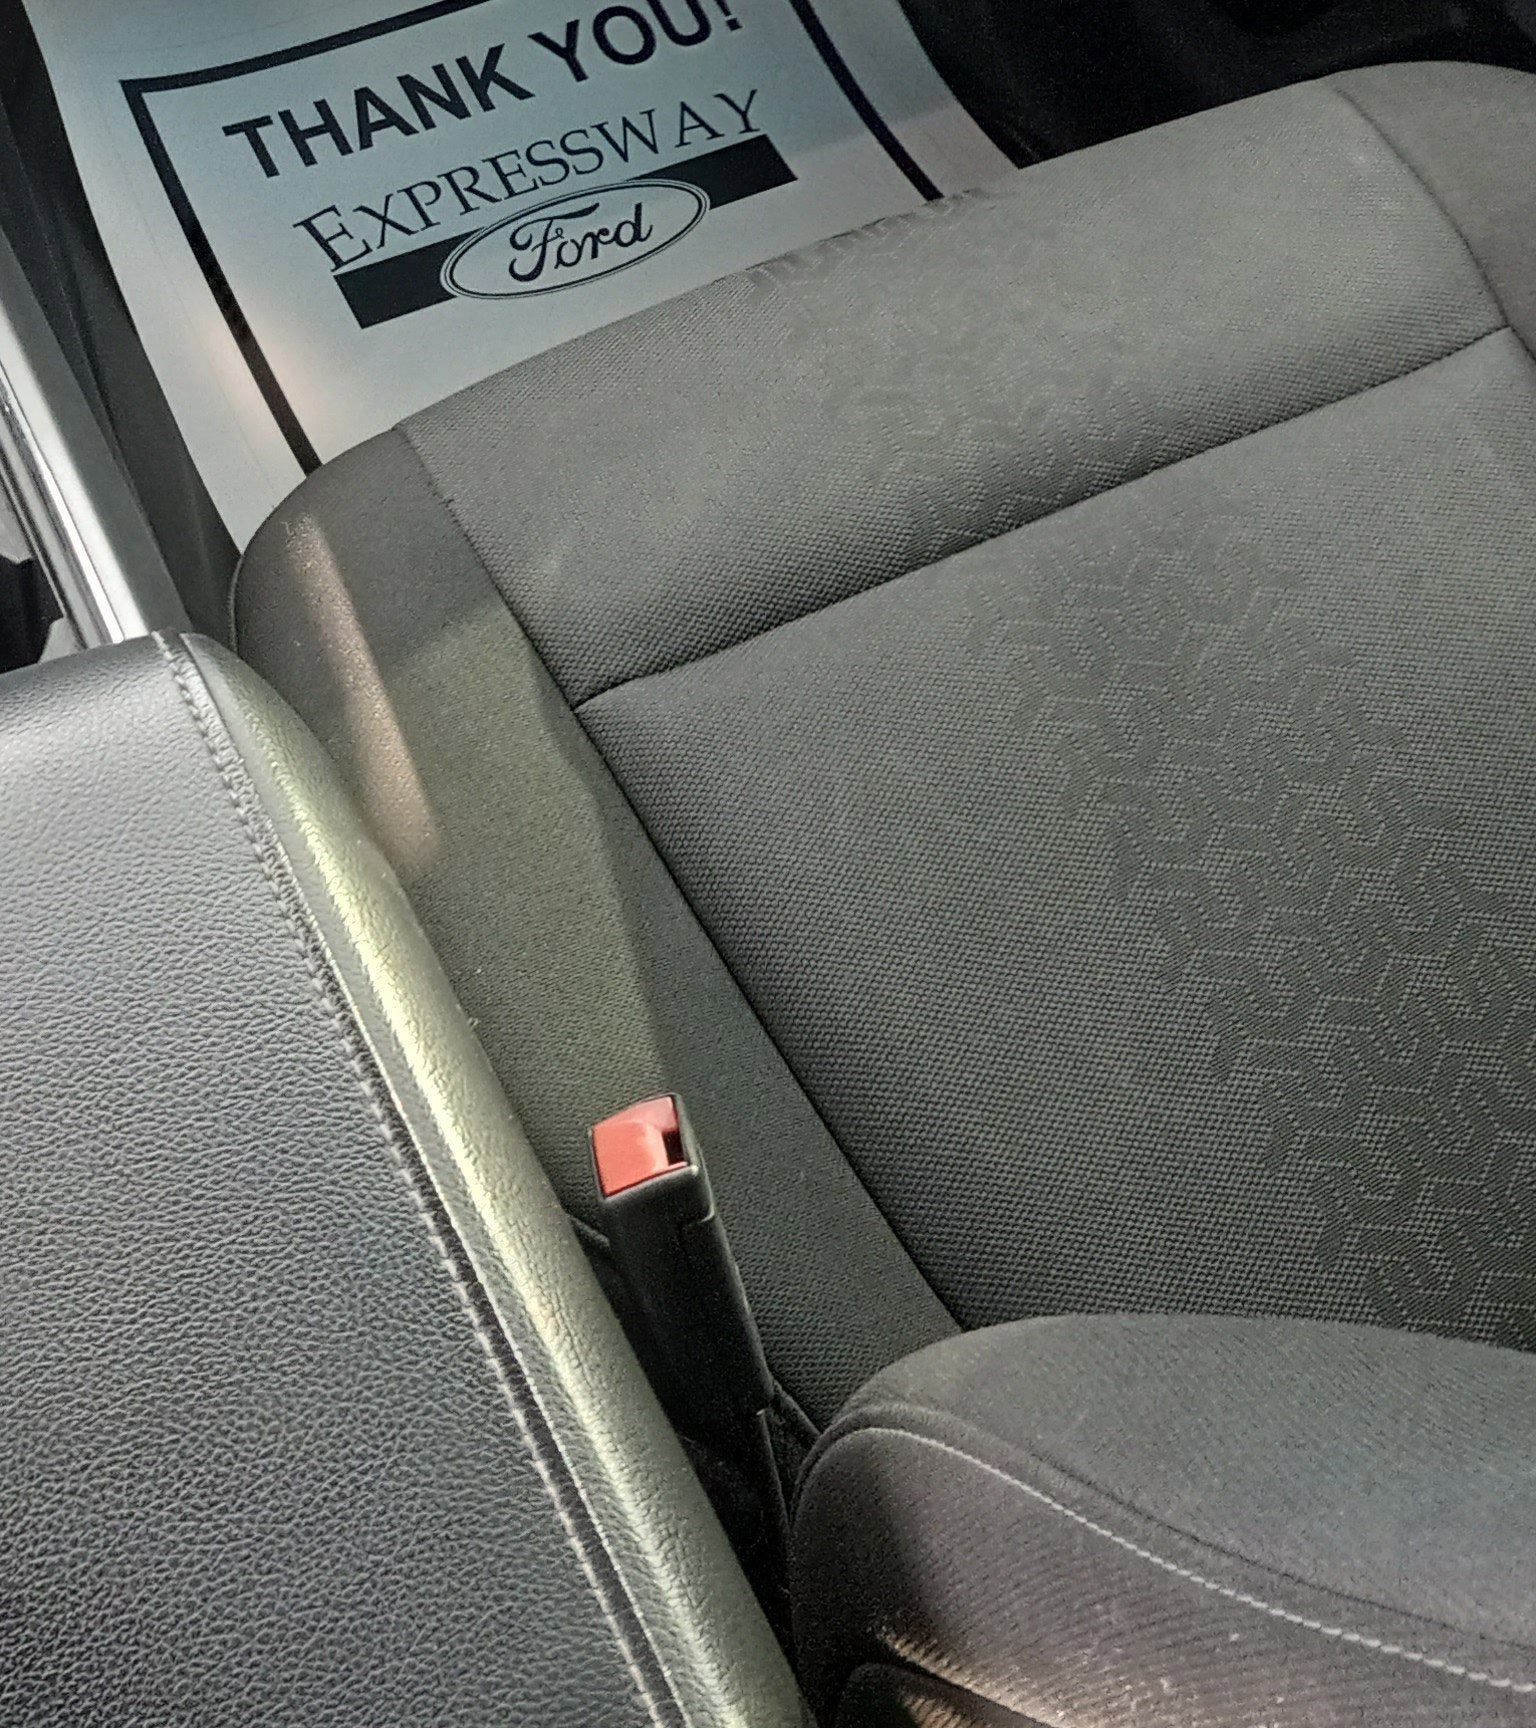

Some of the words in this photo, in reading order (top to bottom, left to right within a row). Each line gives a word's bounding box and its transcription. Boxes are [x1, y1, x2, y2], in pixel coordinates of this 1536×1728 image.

[222, 43, 535, 179] THANK
[293, 89, 765, 273] EXPRESSWAY
[507, 201, 654, 282] Ford
